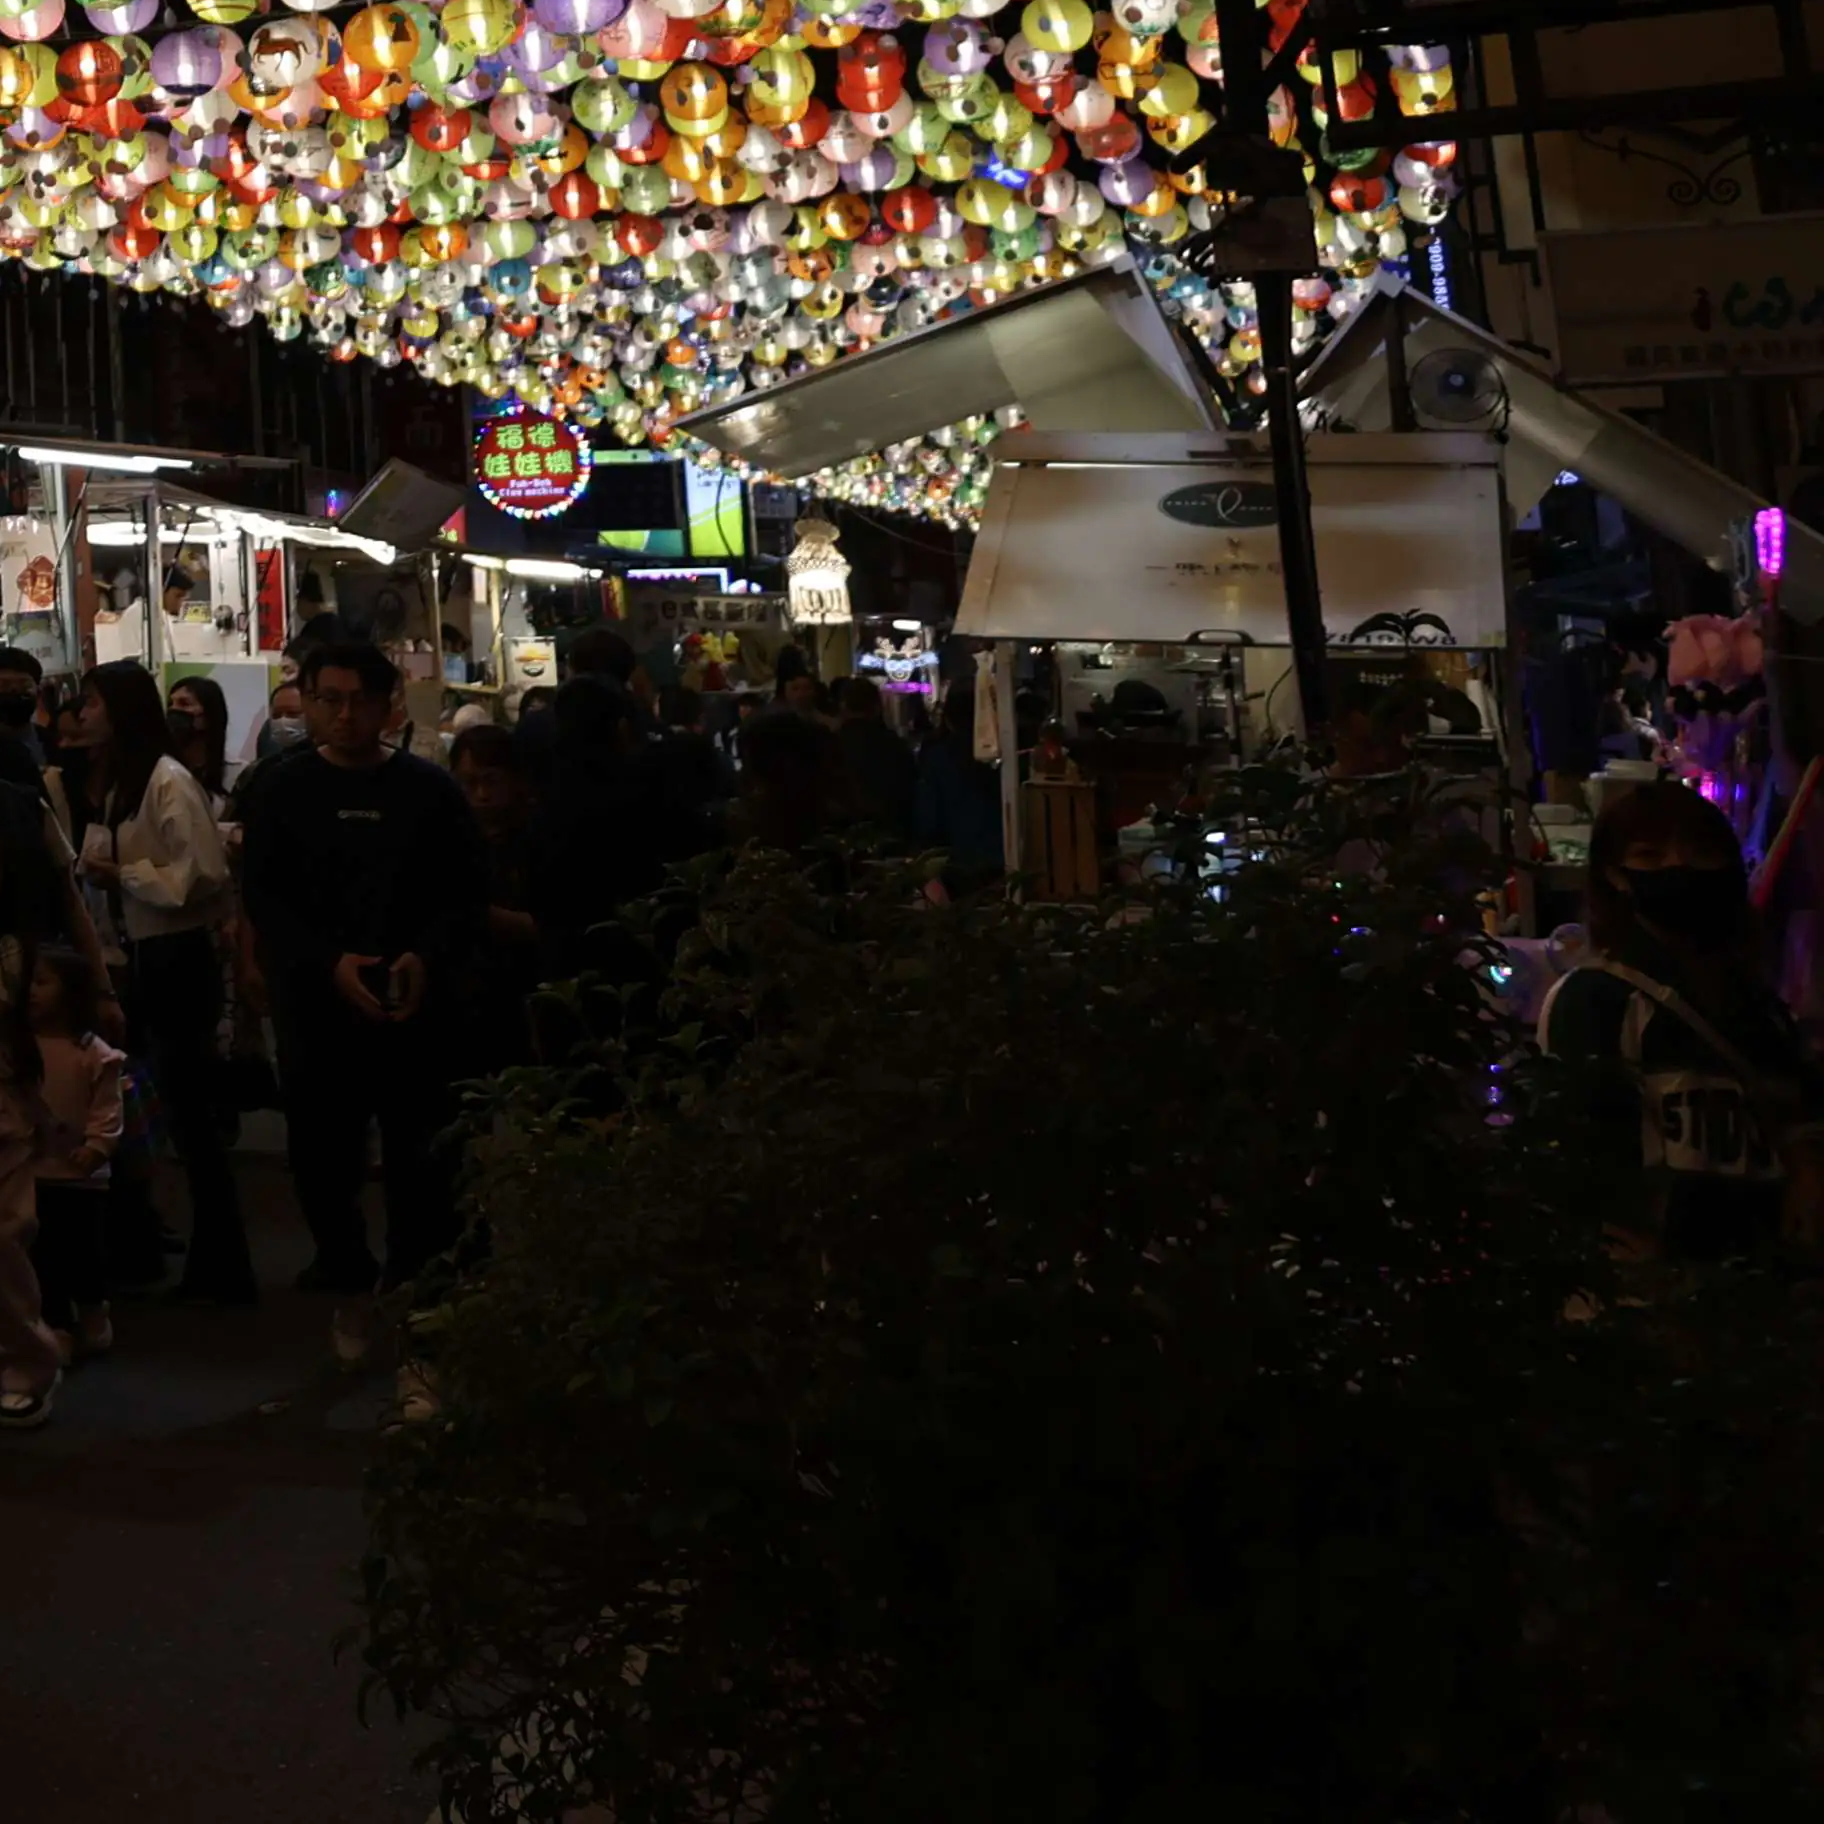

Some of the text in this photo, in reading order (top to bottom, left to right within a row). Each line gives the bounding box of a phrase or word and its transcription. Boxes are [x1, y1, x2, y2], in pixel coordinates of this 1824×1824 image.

[495, 421, 557, 450] 福德
[483, 448, 574, 478] 娃娃機
